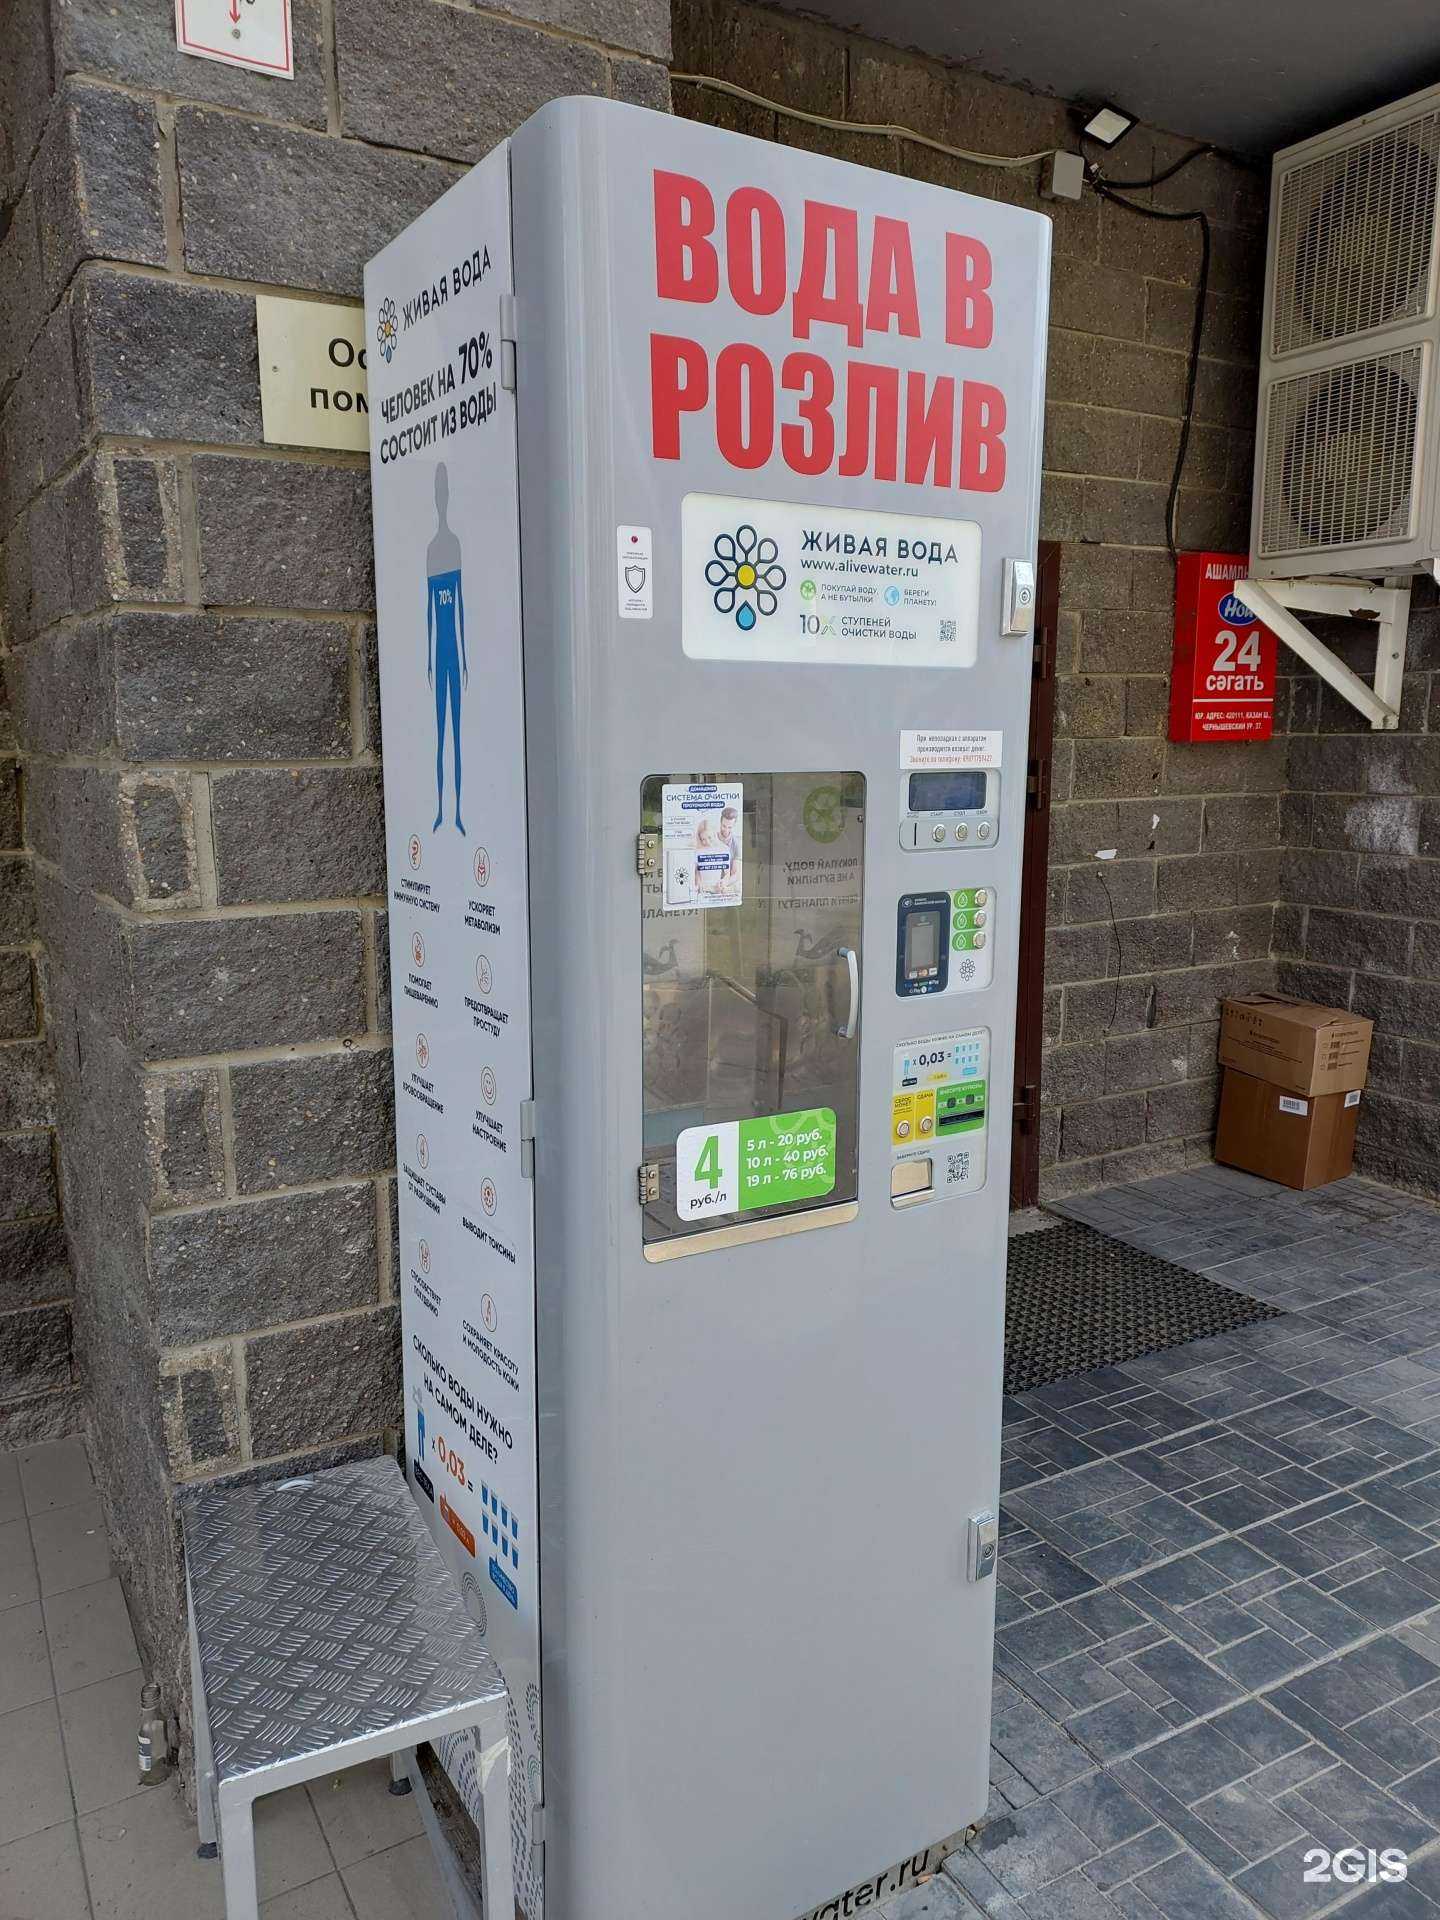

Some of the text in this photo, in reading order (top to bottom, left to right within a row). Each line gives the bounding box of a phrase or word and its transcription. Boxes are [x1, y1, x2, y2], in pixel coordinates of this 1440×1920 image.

[653, 168, 994, 349] ВОДА В
[403, 245, 491, 331] ЖИВАЯ ВОДА
[381, 331, 493, 423] ЧЕЛОВЕК НА 70%
[380, 382, 497, 464] СОСТОИТ ИЗ ВОДЫ
[650, 332, 1007, 493] РОЗЛИВ
[801, 530, 959, 565] ЖИВАЯ ВОДА
[801, 559, 919, 577] www.alivewater.ru
[439, 588, 452, 605] 70%
[821, 583, 857, 594] ПОКУПАЙ
[904, 589, 930, 598] БЕРЕГИ
[841, 616, 892, 628] СТУПЕНЕЙ
[841, 628, 917, 641] ОЧИСТКИ ВОДЫ
[1213, 630, 1261, 672] 24
[1205, 675, 1264, 691] сәгать
[916, 734, 926, 742] При
[666, 794, 703, 802] СИСТЕМА
[419, 899, 441, 913] СИСТЕМУ
[468, 900, 496, 917] УСКОРЯЕТ
[464, 915, 501, 935] МЕТАБОЛИЗМ
[408, 972, 432, 991] ПОМОГАЕТ
[464, 996, 509, 1024] ПРЕДОТВРАЩАЕТ
[473, 1016, 501, 1037] ПРОСТУДУ
[919, 1051, 945, 1067] 0,03
[475, 1110, 504, 1135] УЛУЧШАЕТ
[472, 1124, 507, 1153] НАСТРОЕНИЕ
[747, 1139, 755, 1152] 5
[757, 1138, 767, 1150] л
[777, 1134, 794, 1148] 20
[796, 1128, 823, 1147] руб.
[694, 1135, 723, 1190] 4
[746, 1157, 760, 1169] 10
[763, 1156, 772, 1167] л
[783, 1150, 800, 1163] 40
[803, 1145, 829, 1163] руб.
[746, 1175, 760, 1187] 19
[763, 1174, 772, 1184] л
[782, 1168, 798, 1181] 76
[801, 1163, 826, 1180] руб.
[690, 1191, 727, 1210] руб./л
[462, 1217, 516, 1264] ВЫВОДИТ ТОКСИНЫ
[462, 1319, 519, 1374] СОХРАНЯЕТ КРАСОТУ
[467, 1338, 502, 1376] МОЛОДОСТЬ
[502, 1369, 520, 1393] КОЖИ
[412, 1335, 513, 1450] СКОЛЬКО ВОДЫ НУЖНО
[423, 1373, 498, 1464] НА САМОМ ДЕЛЕ?
[438, 1436, 466, 1486] 0,03
